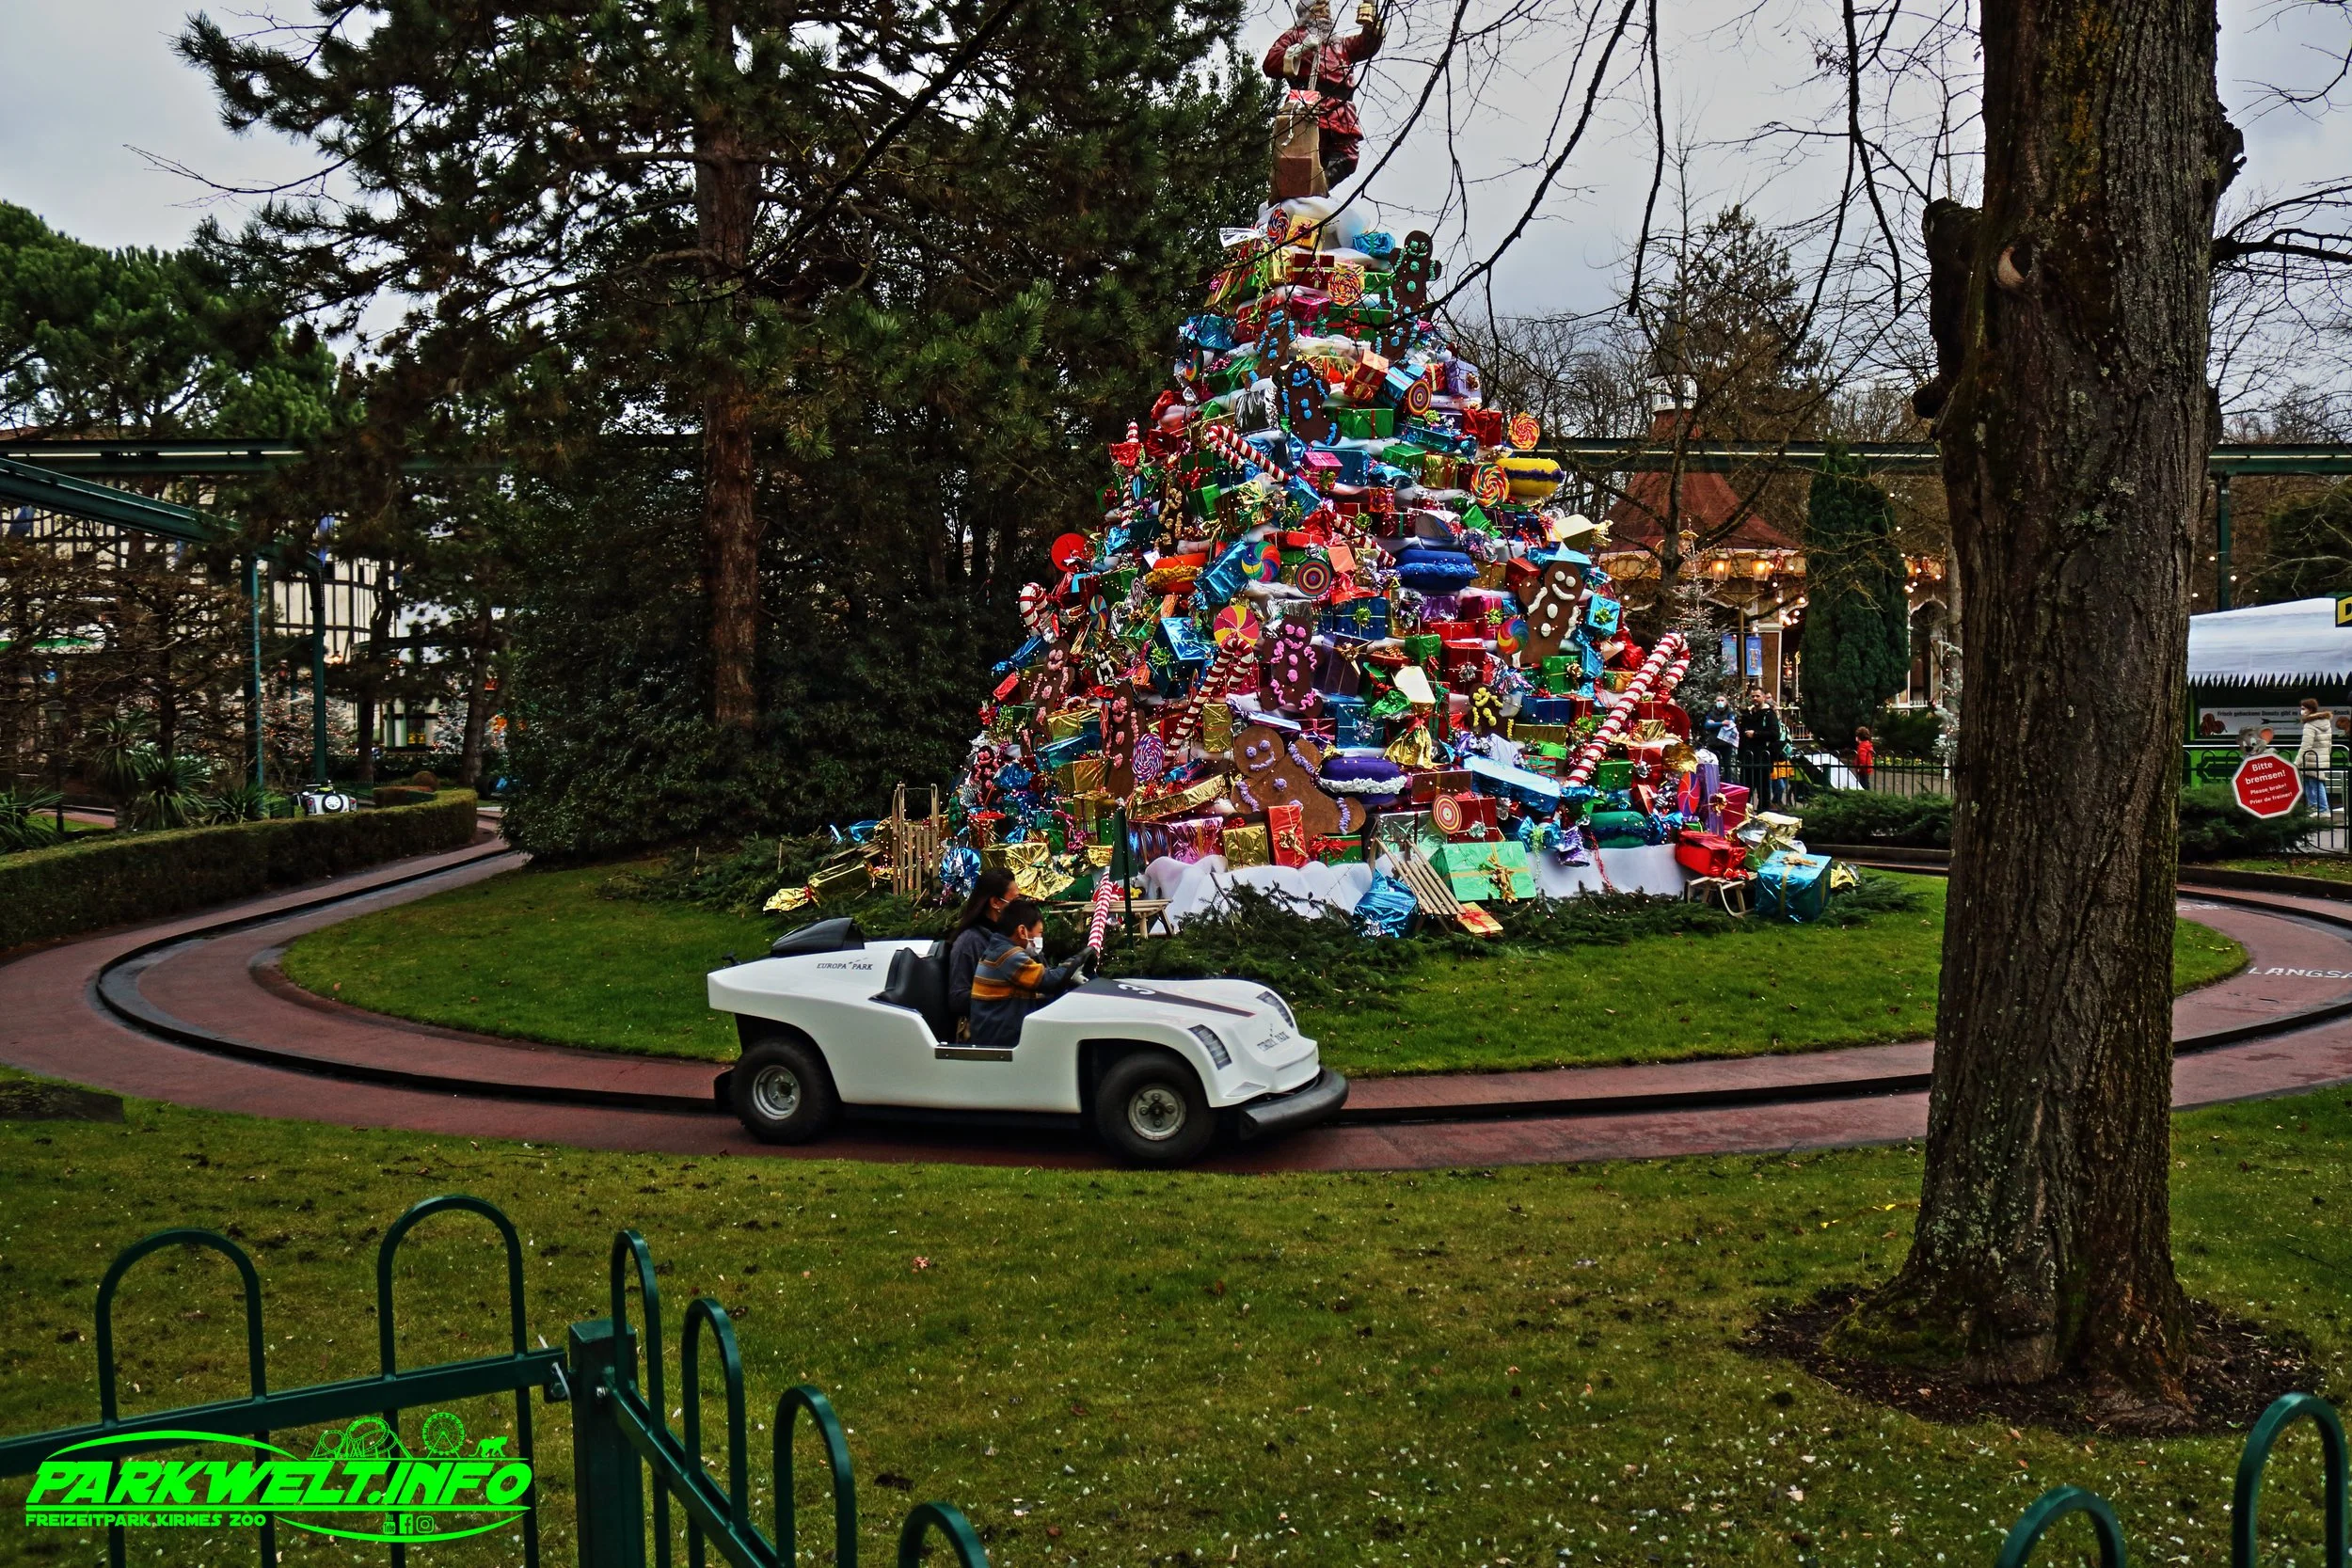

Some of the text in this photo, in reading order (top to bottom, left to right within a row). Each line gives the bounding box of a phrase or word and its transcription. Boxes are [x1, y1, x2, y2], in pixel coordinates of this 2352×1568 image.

[2251, 762, 2273, 772] Bitte
[2245, 769, 2286, 784] bremsen!
[1118, 983, 1156, 995] 3
